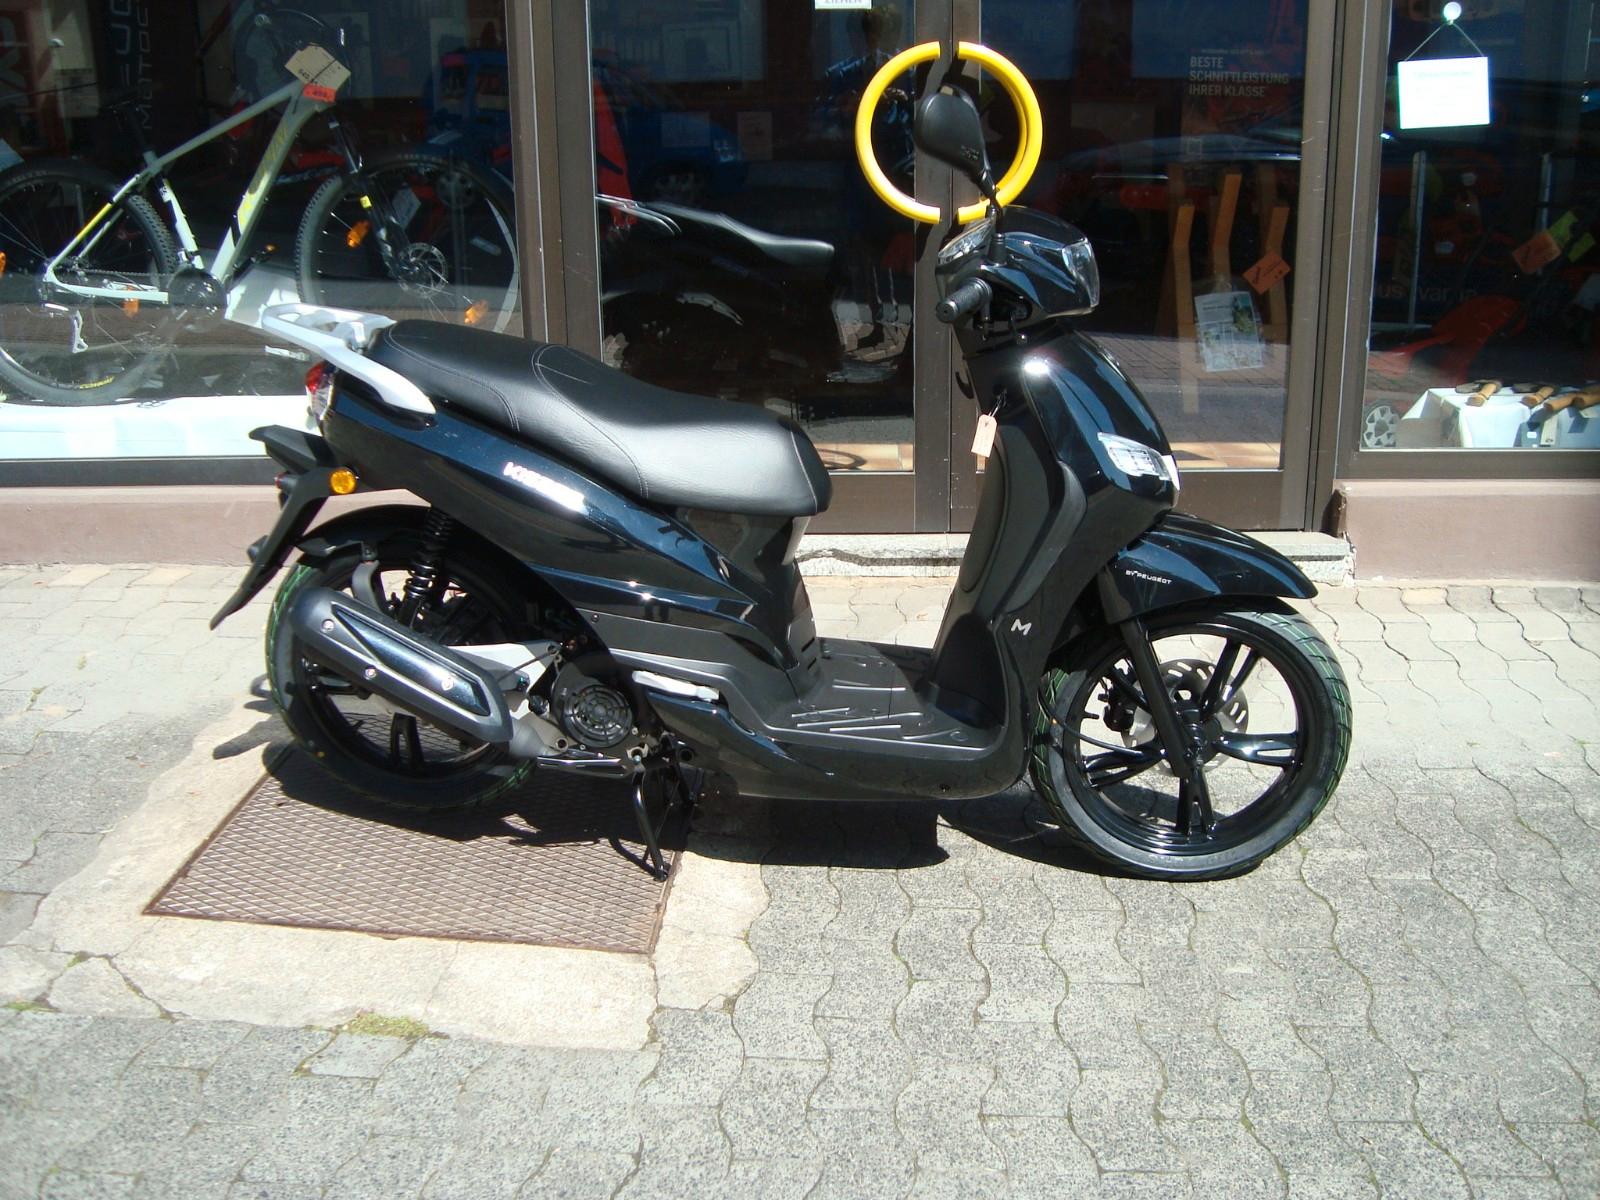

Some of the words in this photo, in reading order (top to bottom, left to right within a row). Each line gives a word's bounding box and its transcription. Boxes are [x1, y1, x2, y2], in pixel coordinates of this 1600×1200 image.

[137, 0, 153, 129] MOTOC
[1189, 56, 1224, 69] BESTE
[1189, 70, 1289, 84] SCHNITTLEISTUNG
[1188, 84, 1222, 97] IHRER
[1224, 85, 1266, 97] KLASSE
[1136, 572, 1172, 585] PEUGEOT
